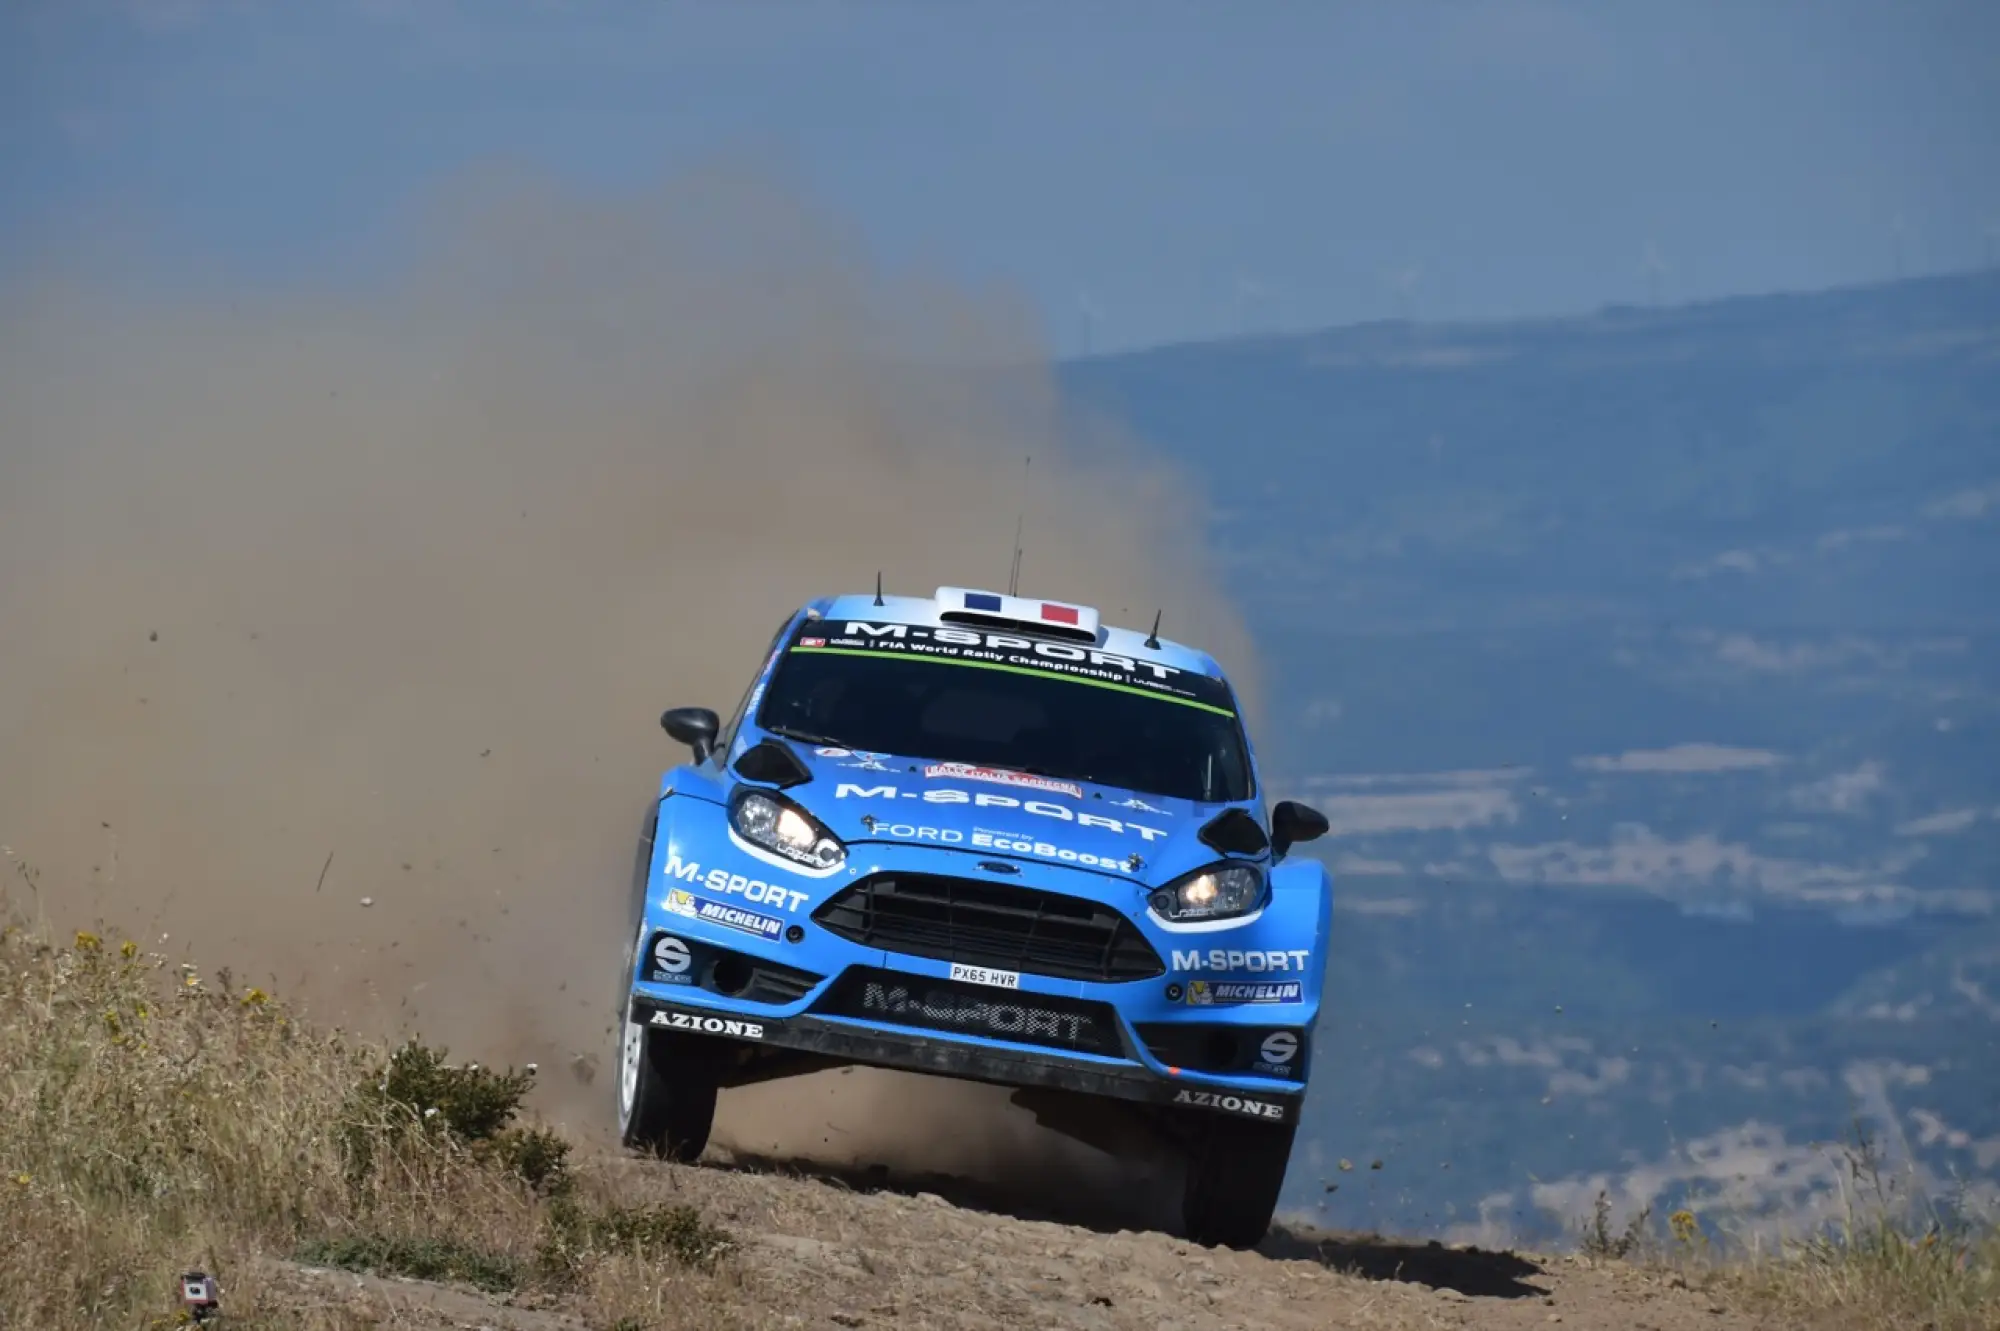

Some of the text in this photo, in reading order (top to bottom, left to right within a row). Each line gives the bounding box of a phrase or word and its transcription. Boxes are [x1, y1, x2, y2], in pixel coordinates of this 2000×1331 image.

[844, 621, 1180, 679] M-SPORT
[879, 641, 1123, 682] FIA World Rally Championship
[835, 783, 1168, 841] M-SPORT
[872, 822, 964, 843] FORD
[664, 855, 809, 913] M-SPORT
[700, 903, 782, 936] MICHELIN
[952, 966, 1016, 986] PX65 HVR
[1171, 949, 1310, 973] M-SPORT
[1215, 984, 1298, 998] MICHELIN
[650, 1010, 764, 1039] AZIONE
[1173, 1089, 1284, 1119] AZIONE
